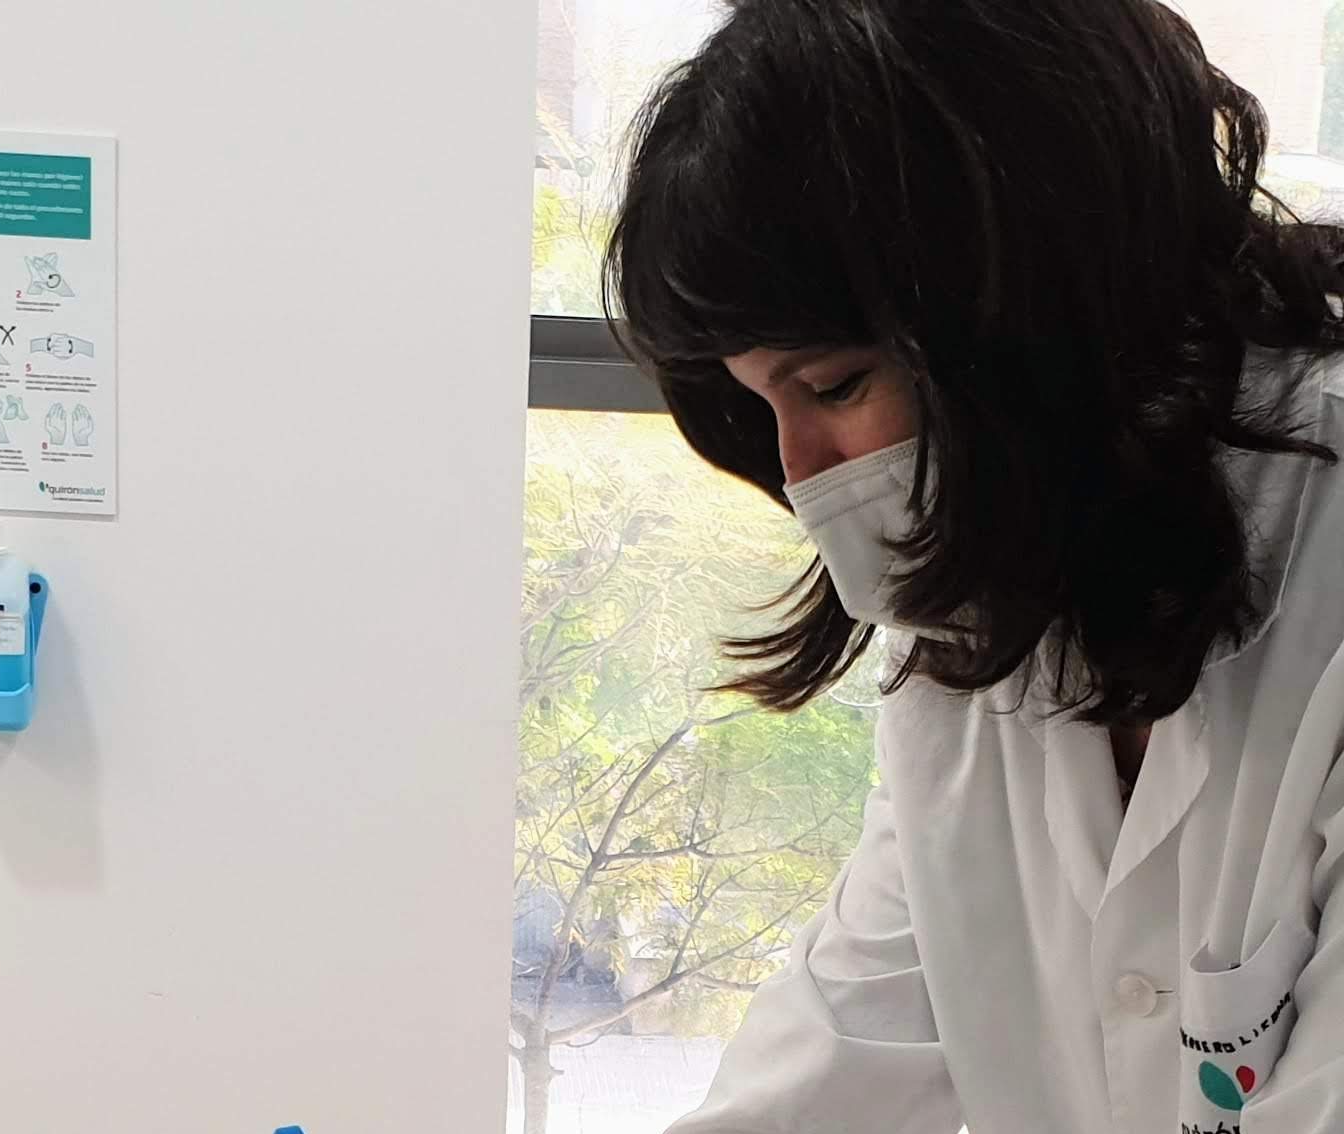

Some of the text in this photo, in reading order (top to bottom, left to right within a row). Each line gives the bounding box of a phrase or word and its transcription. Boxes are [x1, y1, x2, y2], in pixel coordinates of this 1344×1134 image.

[16, 290, 22, 298] 2
[26, 364, 32, 372] 5
[42, 442, 48, 450] 8
